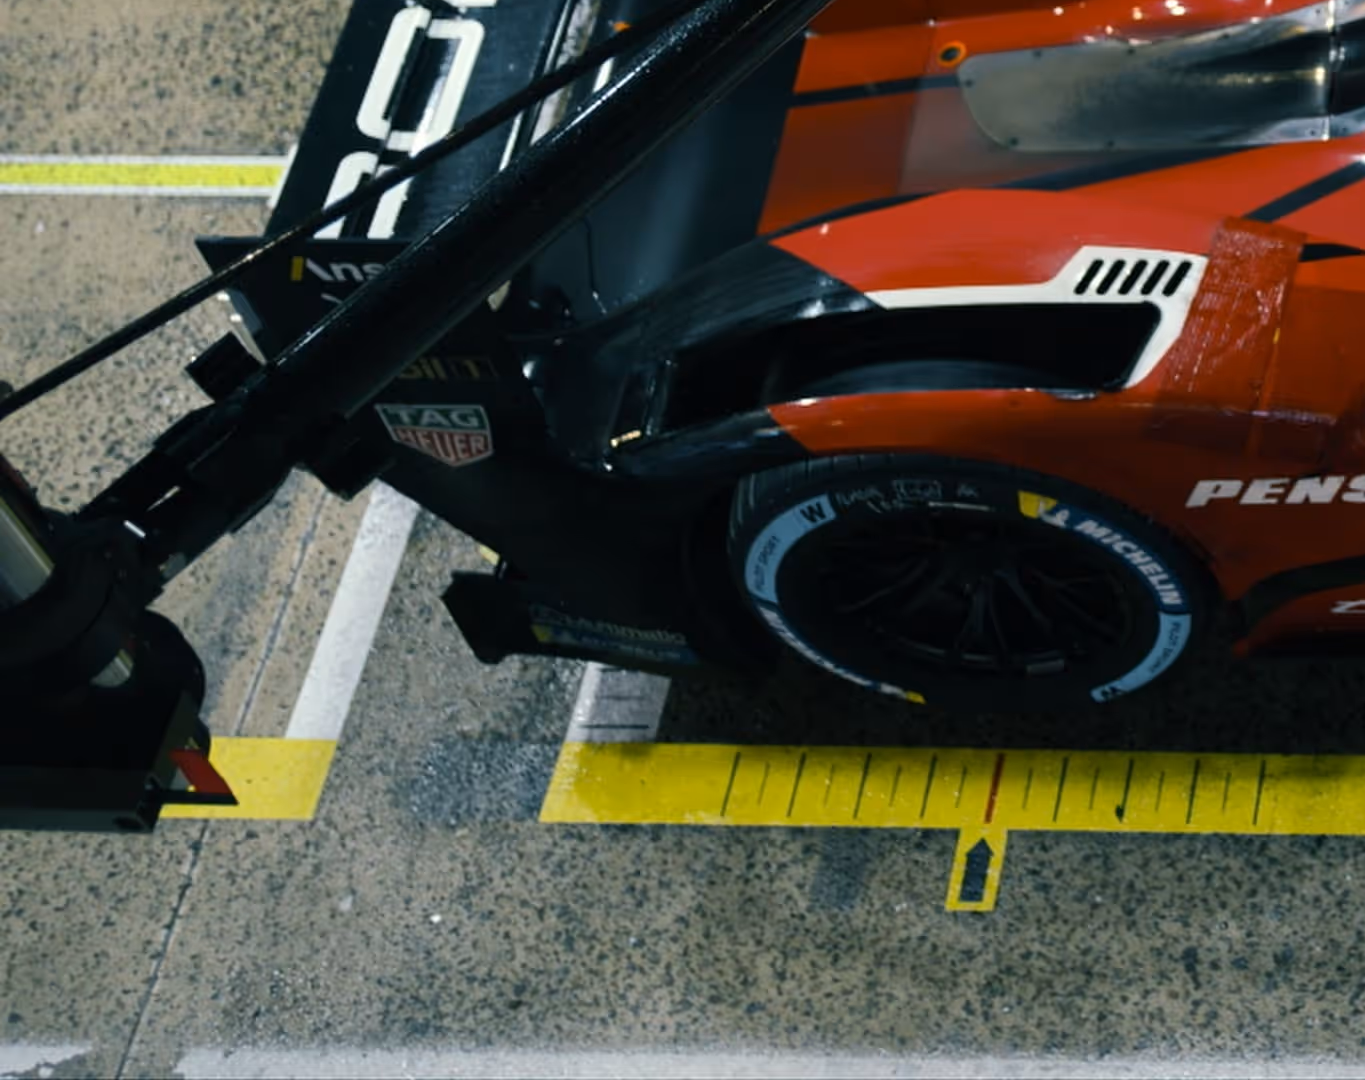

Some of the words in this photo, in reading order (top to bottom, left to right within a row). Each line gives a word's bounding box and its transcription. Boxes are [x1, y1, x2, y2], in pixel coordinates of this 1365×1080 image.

[385, 408, 480, 428] TAG
[396, 429, 485, 462] HEUER
[1074, 519, 1184, 605] MICHELIN
